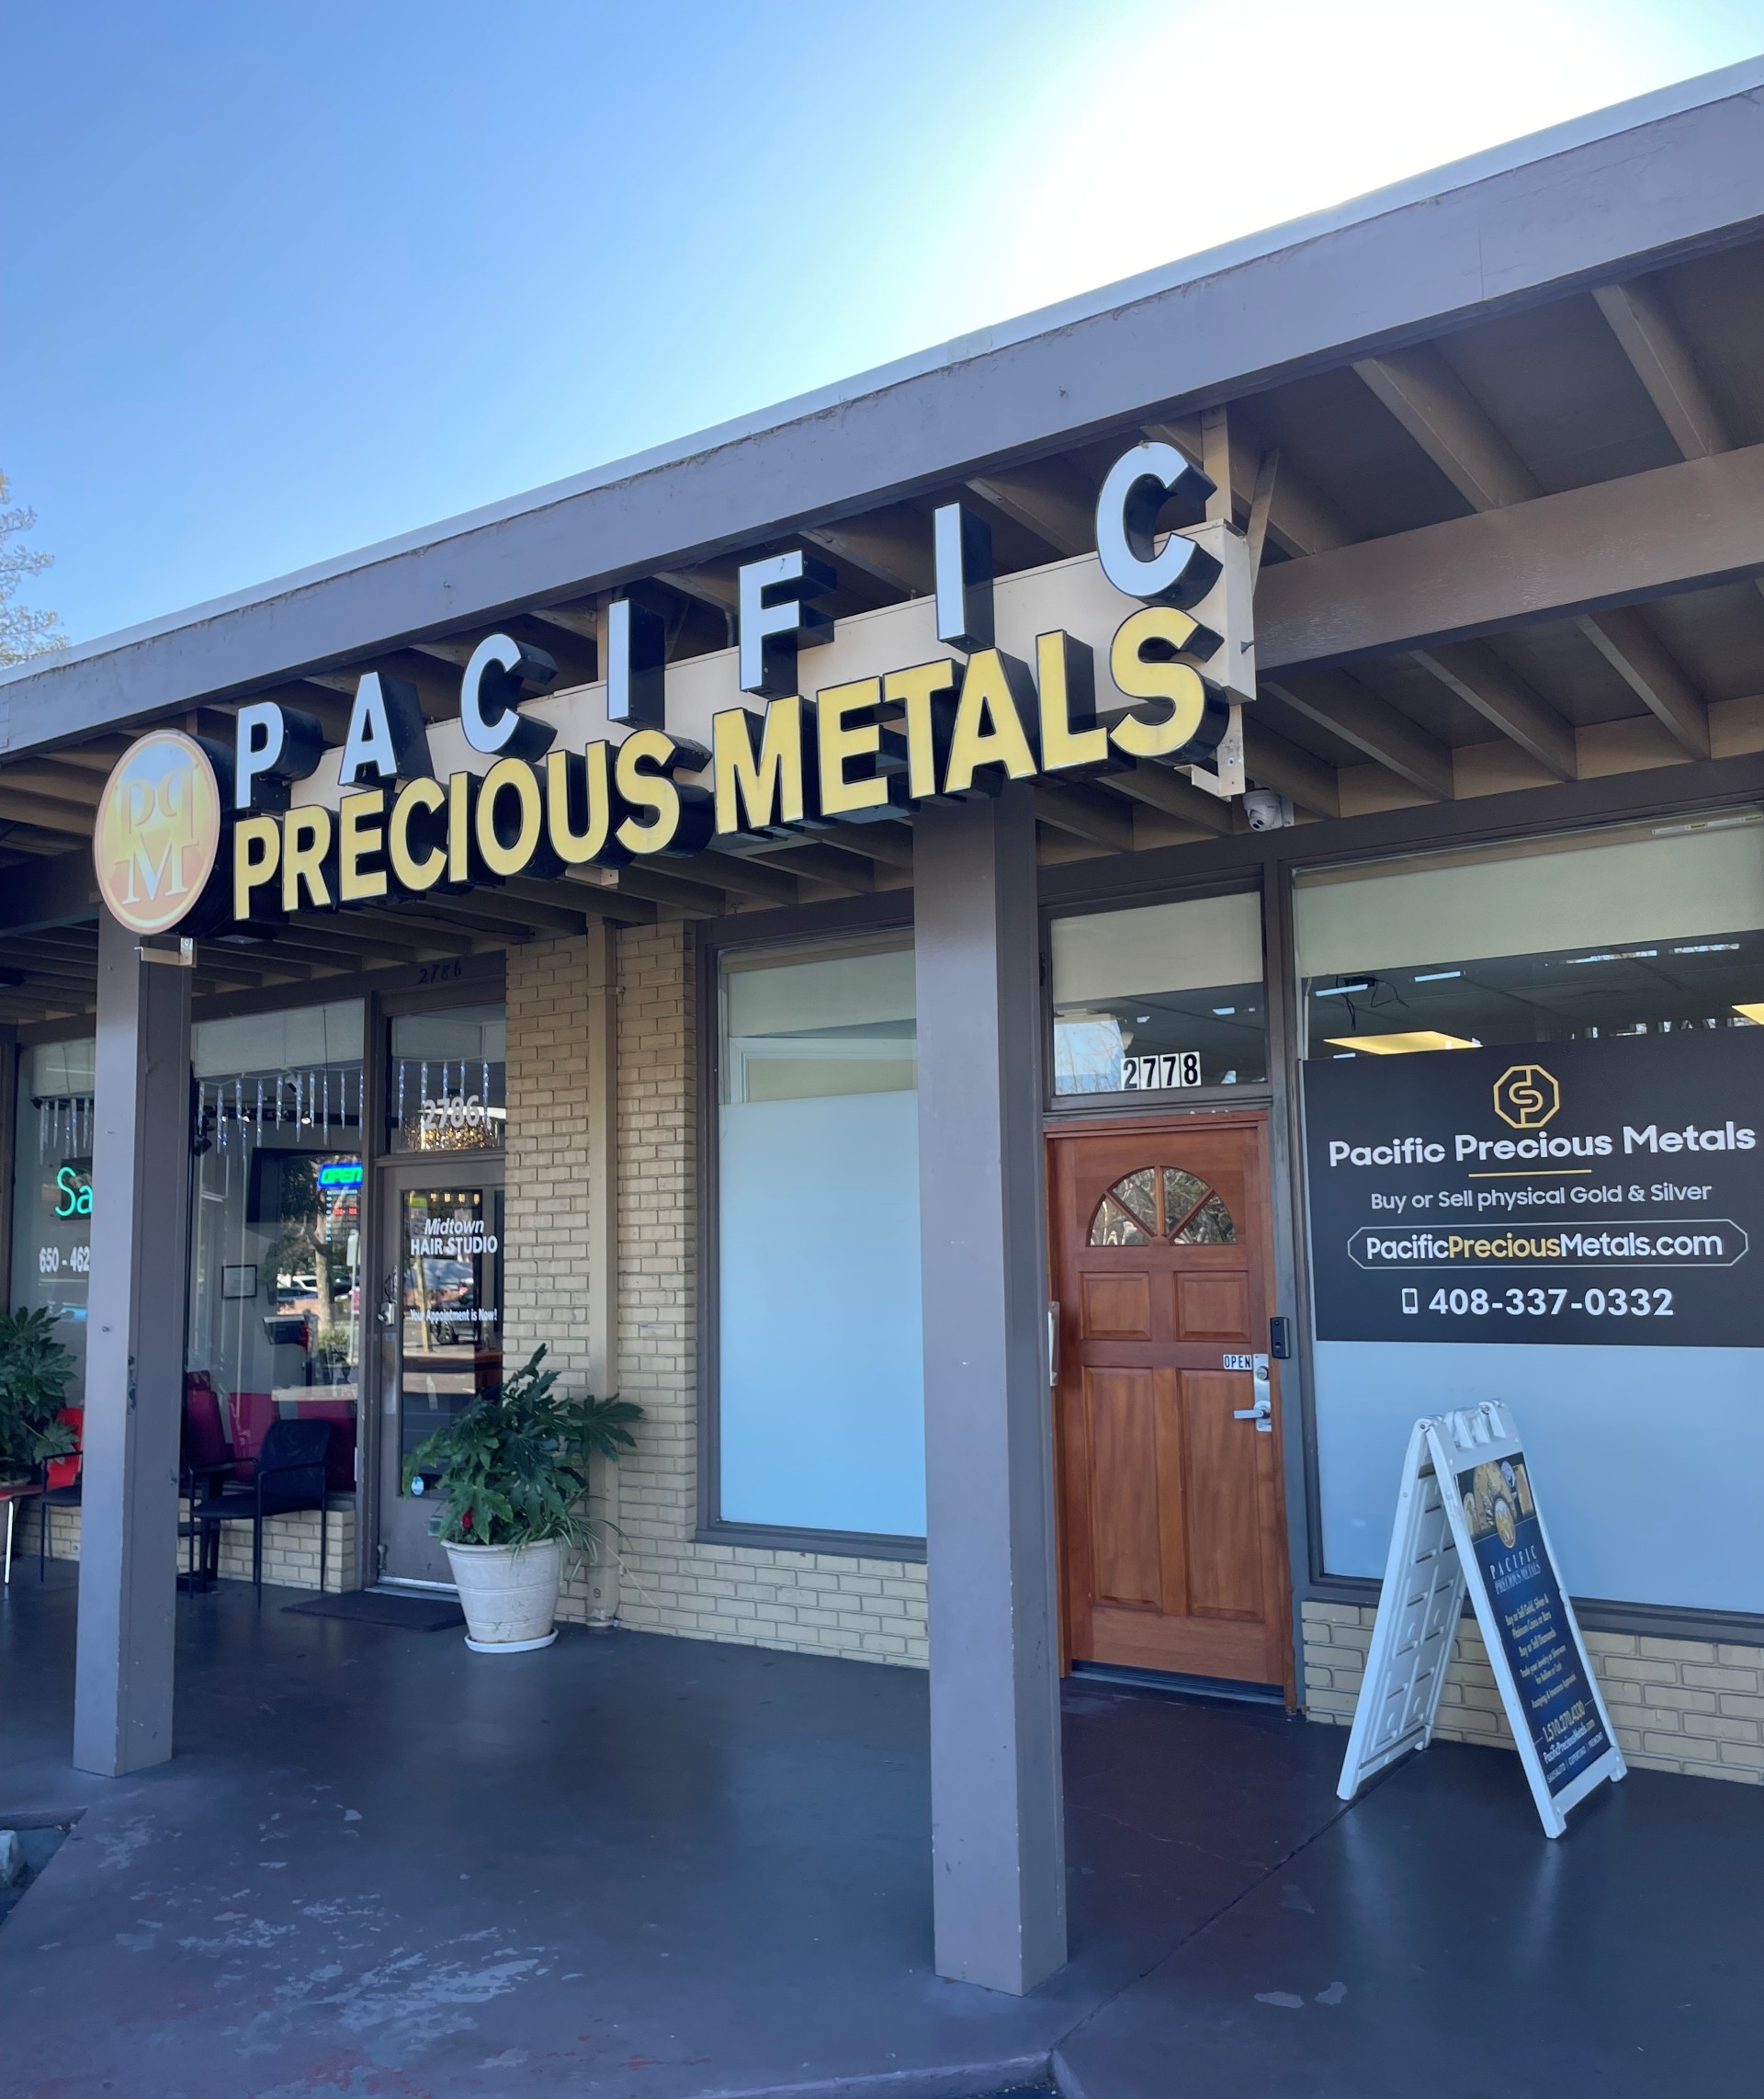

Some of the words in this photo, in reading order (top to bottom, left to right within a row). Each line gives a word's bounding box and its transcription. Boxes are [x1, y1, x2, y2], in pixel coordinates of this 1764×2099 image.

[235, 440, 1197, 809] PACIFIC
[233, 728, 681, 921] PRECIOUS
[712, 606, 1206, 835] METALS
[418, 961, 463, 984] 2786
[1123, 1054, 1198, 1089] 2778
[424, 1095, 480, 1130] 2786
[1329, 1138, 1446, 1167] Pacific
[1454, 1130, 1612, 1162] Precious
[1623, 1120, 1756, 1154] Metals
[1371, 1193, 1407, 1214] Buy
[1411, 1193, 1433, 1208] or
[1438, 1190, 1473, 1208] Sell
[1477, 1186, 1566, 1212] physical
[1569, 1185, 1623, 1205] Gold
[1627, 1186, 1645, 1203] &
[1650, 1182, 1713, 1202] Silver
[424, 1218, 484, 1235] Midtown
[411, 1238, 443, 1255] HAIR
[447, 1236, 498, 1255] STUDIO
[1366, 1231, 1724, 1260] PacificPreciousMetals.com
[39, 1247, 60, 1274] 650
[410, 1309, 424, 1322] Your
[426, 1309, 469, 1324] Appointment
[470, 1309, 478, 1322] is
[479, 1308, 498, 1322] Now!
[1429, 1288, 1674, 1317] 408-337-0332
[1224, 1356, 1251, 1368] OPEN
[1489, 1545, 1537, 1579] PACIFIC
